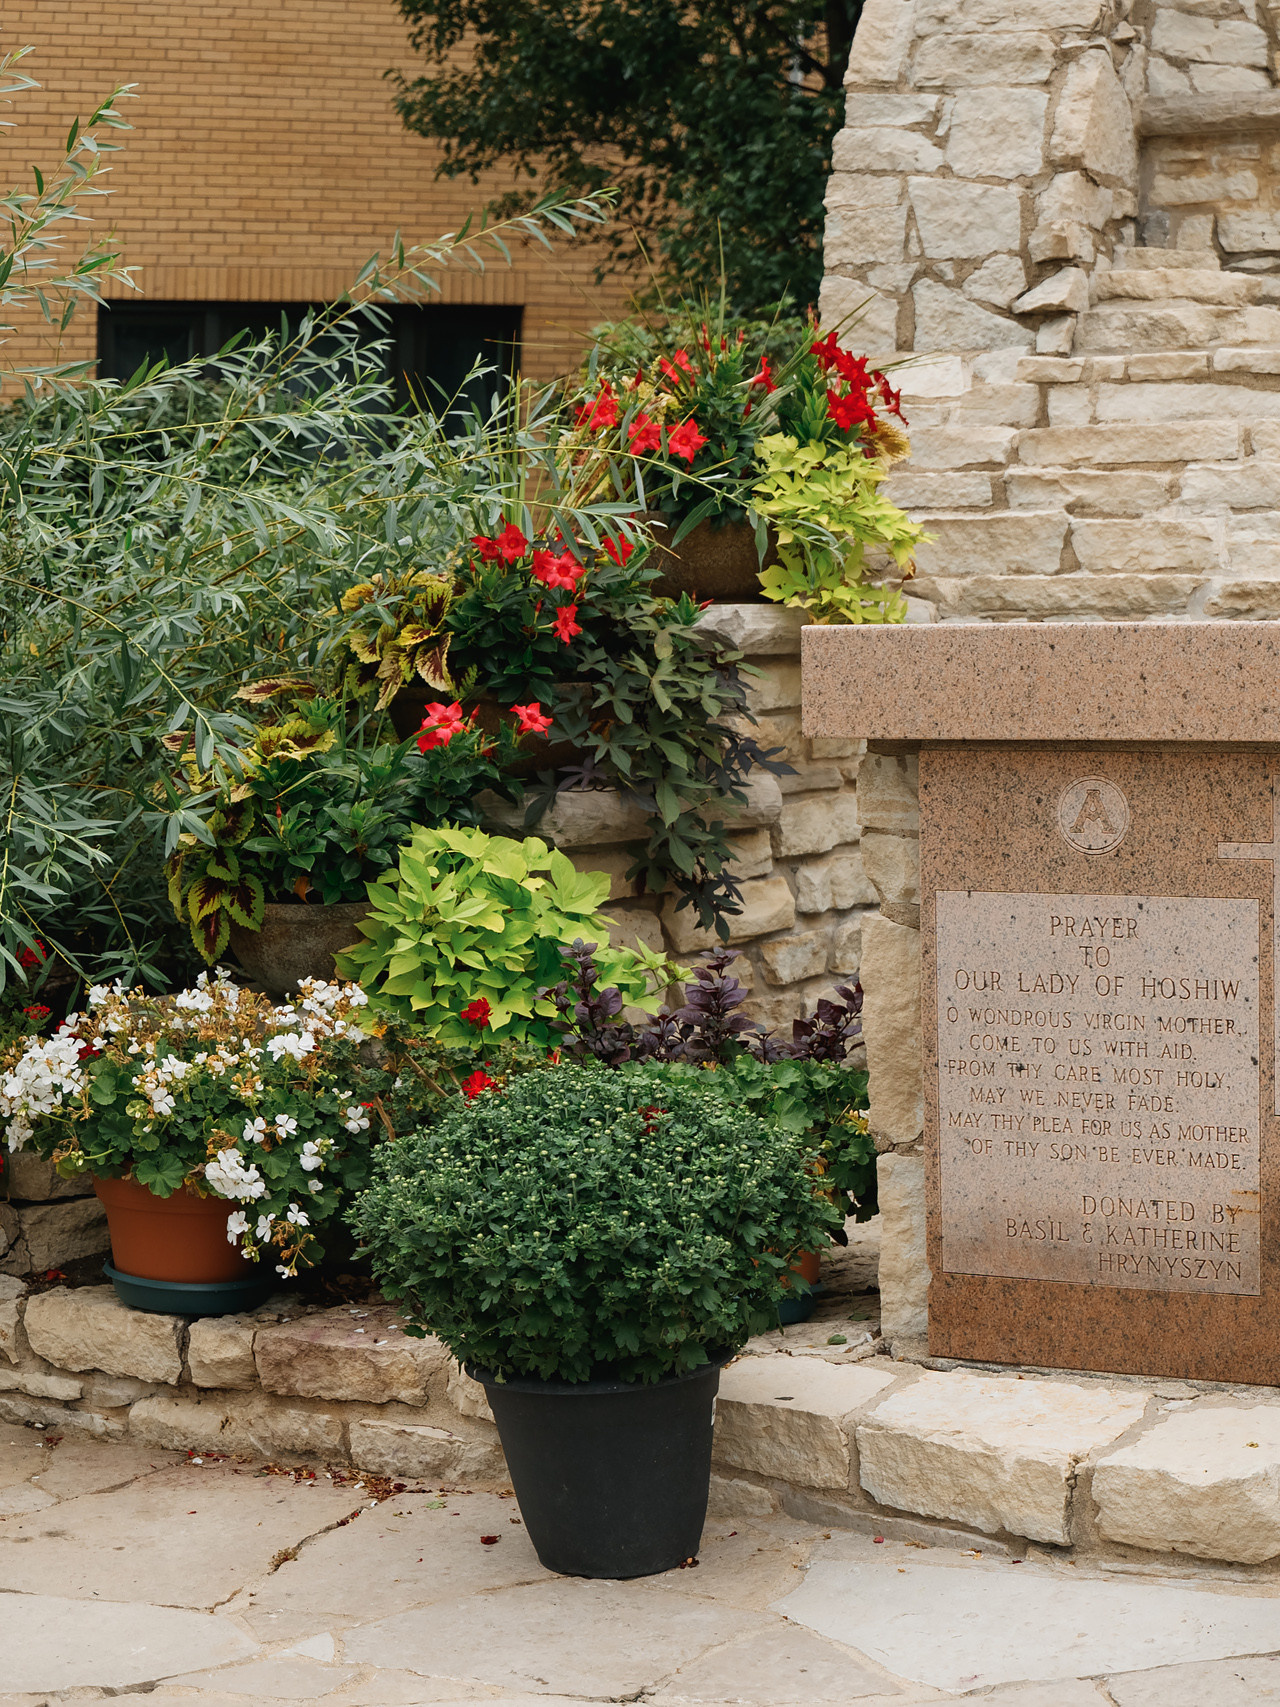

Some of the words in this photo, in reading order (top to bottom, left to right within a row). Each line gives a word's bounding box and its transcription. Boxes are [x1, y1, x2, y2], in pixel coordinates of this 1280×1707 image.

[1050, 916, 1139, 939] PRAYER
[1079, 946, 1110, 968] TO
[954, 969, 1003, 992] OUR
[1018, 973, 1080, 995] LADY
[1095, 975, 1124, 997] OF
[1141, 977, 1241, 1001] HOSHIW
[946, 1006, 959, 1023] O
[969, 1008, 1072, 1029] WONDROUS
[1084, 1012, 1146, 1031] VIRGIN
[969, 1034, 1020, 1052] COME
[1032, 1037, 1056, 1053] TO
[1069, 1038, 1092, 1055] US
[1104, 1040, 1148, 1058] WITH
[1161, 1043, 1197, 1060] AID.
[949, 1060, 996, 1077] FROM
[1007, 1062, 1042, 1079] THY
[1054, 1064, 1100, 1082] CARE
[1113, 1068, 1164, 1085] MOST
[1177, 1071, 1231, 1091] HOLY,
[970, 1087, 1006, 1104] MAY
[1020, 1089, 1044, 1106] WE
[1058, 1091, 1115, 1110] NEVER
[1128, 1094, 1179, 1112] FADE.
[949, 1112, 982, 1128] MAY
[991, 1113, 1026, 1131] THY
[1033, 1116, 1073, 1134] PLEA
[1082, 1119, 1112, 1136] FOR
[1120, 1121, 1142, 1139] US
[1149, 1123, 1171, 1140] AS
[1178, 1125, 1250, 1143] MOTHER
[971, 1138, 993, 1155] OF
[1004, 1140, 1040, 1158] THY
[1050, 1143, 1087, 1160] SON
[1099, 1147, 1120, 1163] BE
[1132, 1149, 1177, 1166] EVER
[1189, 1152, 1246, 1170] MADE.
[1082, 1195, 1195, 1222] DONATED
[1212, 1204, 1241, 1224] BY
[1006, 1218, 1069, 1242] BASIL
[1083, 1222, 1093, 1243] &
[1106, 1225, 1241, 1253] KATHERINE
[1099, 1252, 1242, 1281] HRYNYSZYN
